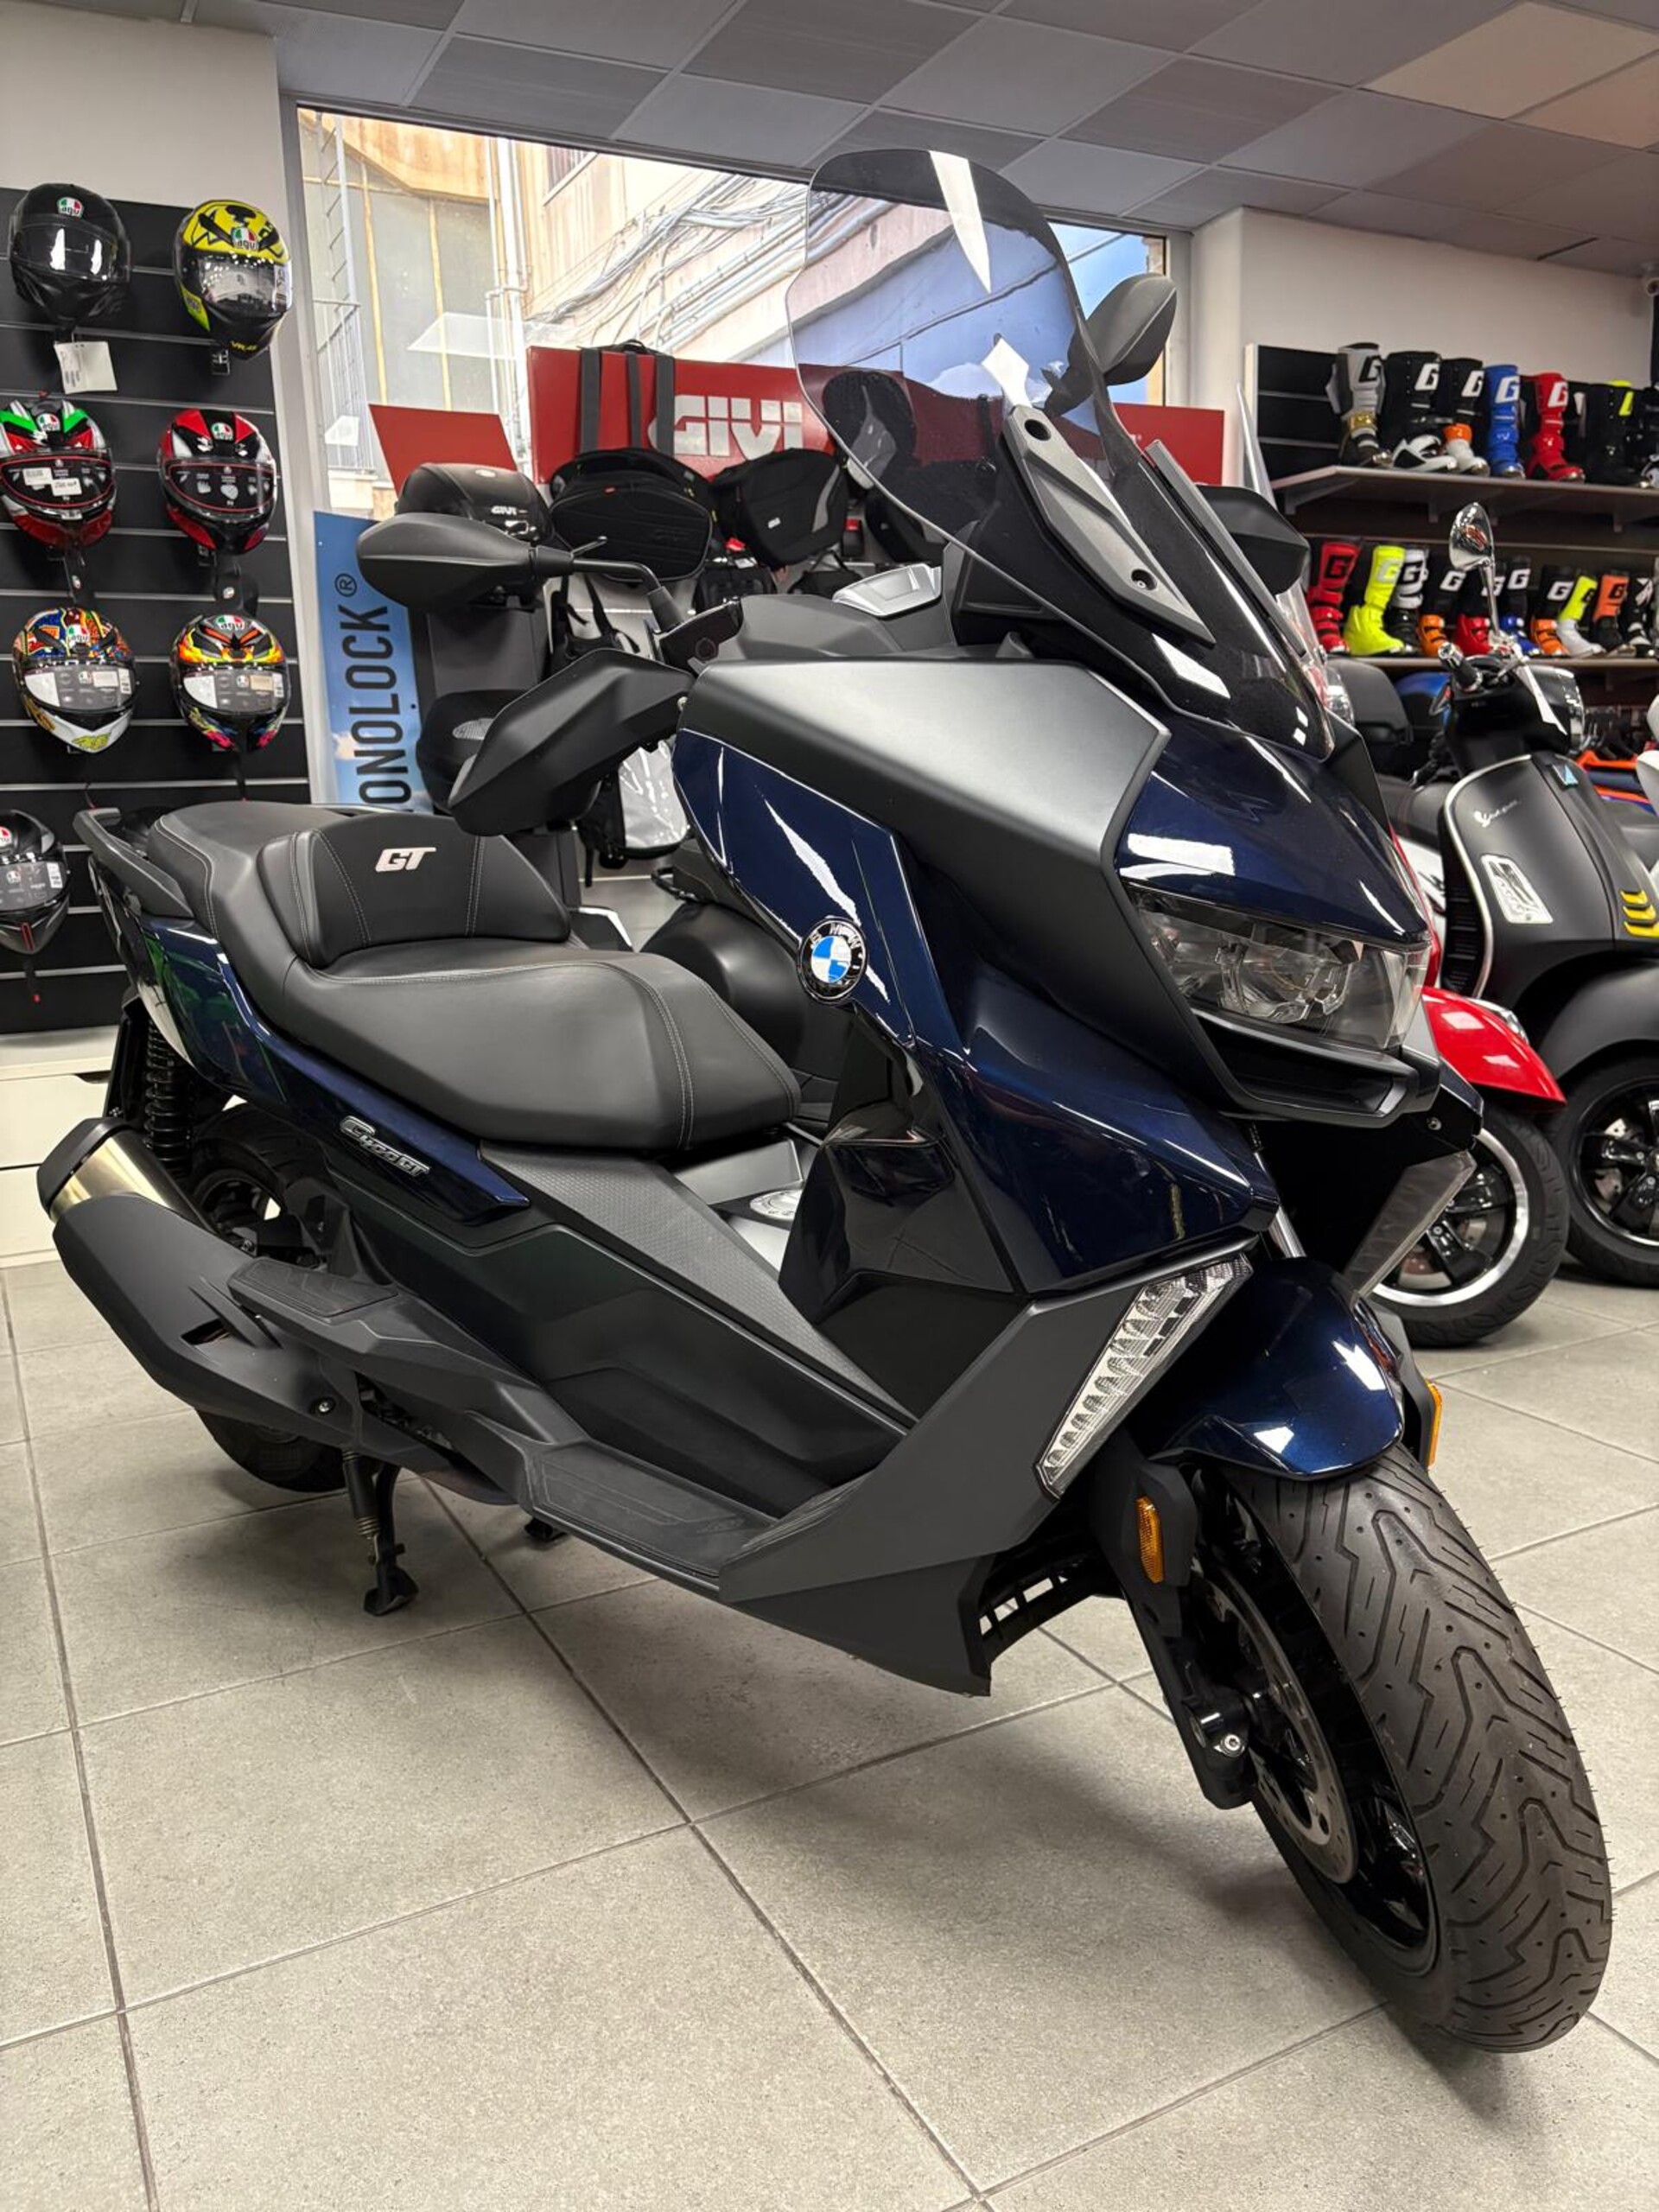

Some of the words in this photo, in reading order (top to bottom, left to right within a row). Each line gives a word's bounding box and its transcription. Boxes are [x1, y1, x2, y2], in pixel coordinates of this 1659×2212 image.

[1414, 363, 1440, 391] G
[1495, 375, 1520, 404] G
[648, 394, 804, 461] GIVI
[1440, 570, 1466, 592] G
[1507, 569, 1531, 589] G
[1547, 581, 1573, 601] G
[334, 573, 412, 811] ONOLOCK®
[375, 847, 437, 873] GT
[810, 921, 862, 950] BMW
